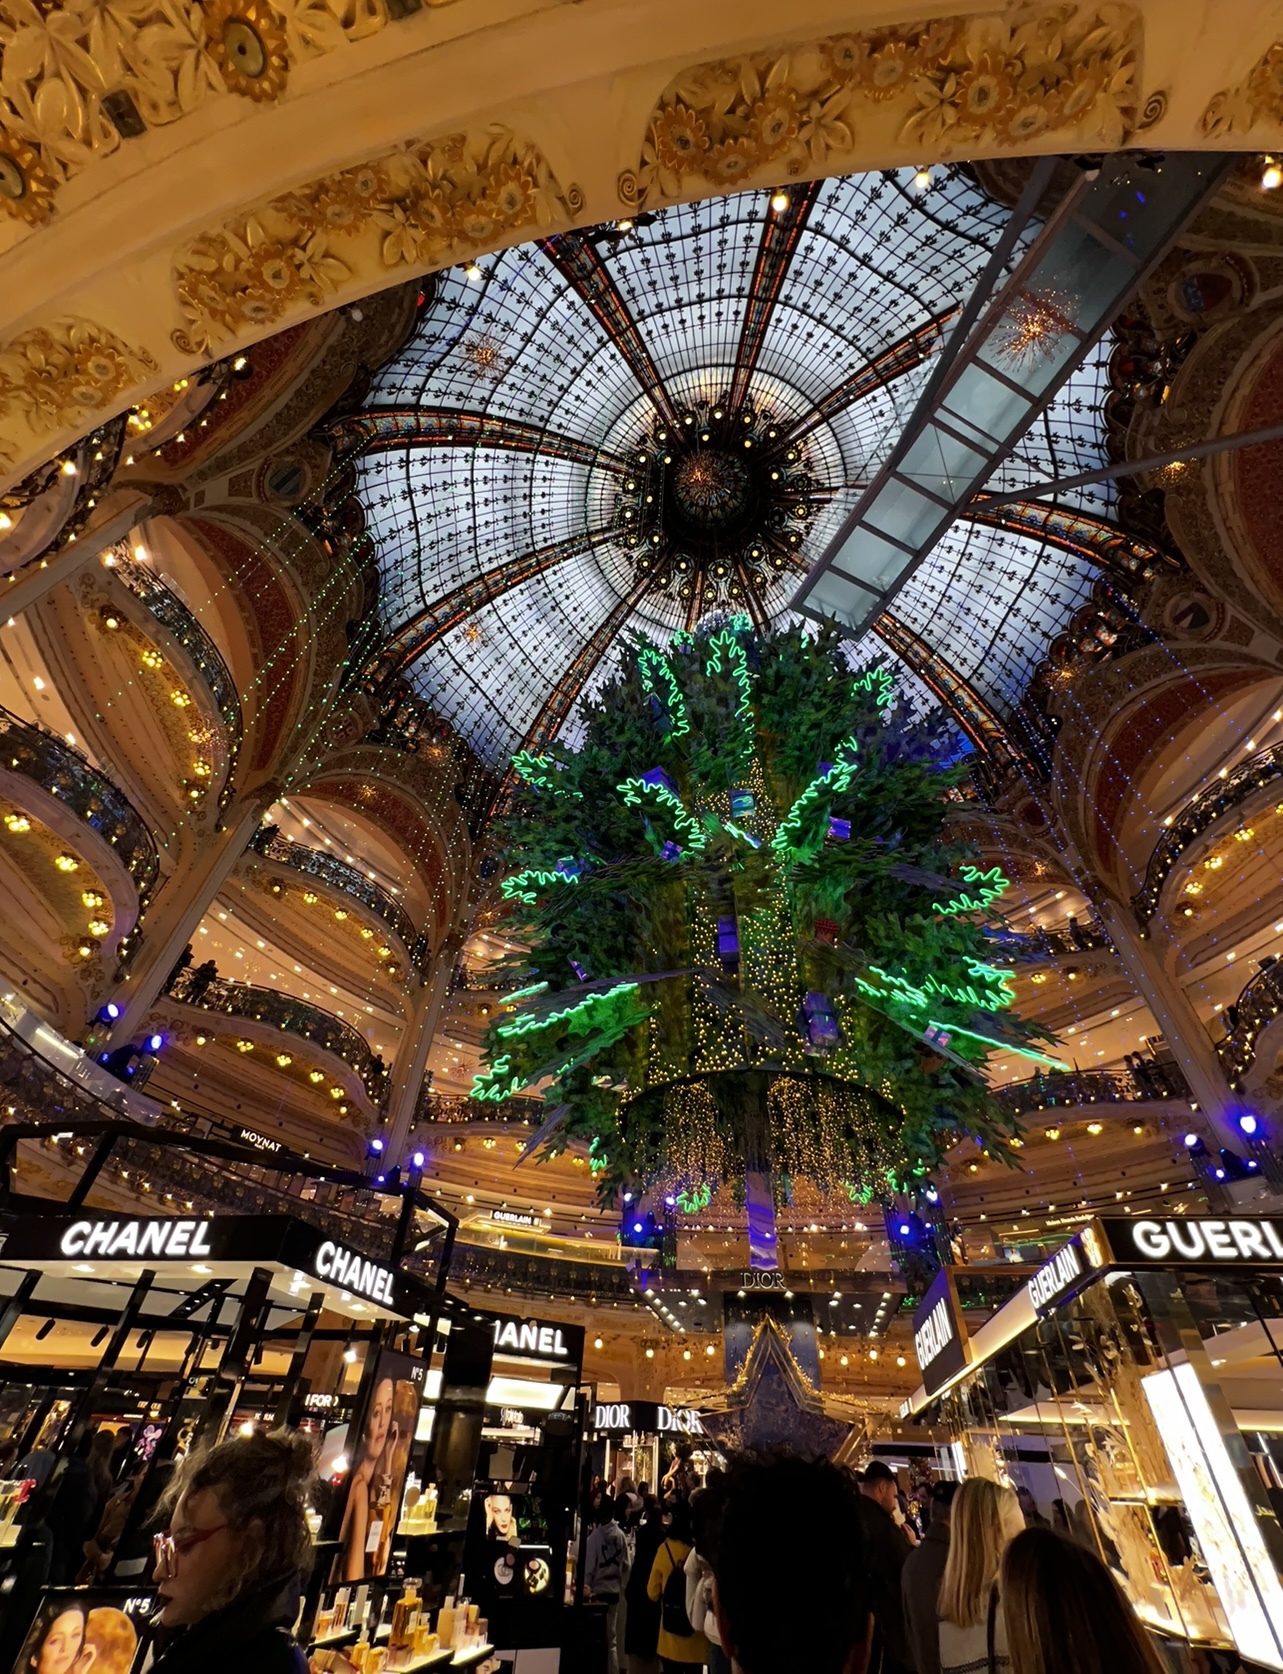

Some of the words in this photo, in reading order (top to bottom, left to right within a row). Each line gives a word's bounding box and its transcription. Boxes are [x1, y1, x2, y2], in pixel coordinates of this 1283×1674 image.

[240, 1129, 282, 1152] MOYNAT
[493, 1211, 532, 1225] GUERLAIN
[60, 1221, 211, 1256] CHANEL
[316, 1241, 394, 1305] CHANEL
[740, 1272, 787, 1289] DIOR
[1027, 1243, 1081, 1309] GUERLAIN
[915, 1297, 953, 1371] GUERLAIN
[594, 1404, 630, 1429] DIOR
[656, 1406, 704, 1434] DIOR
